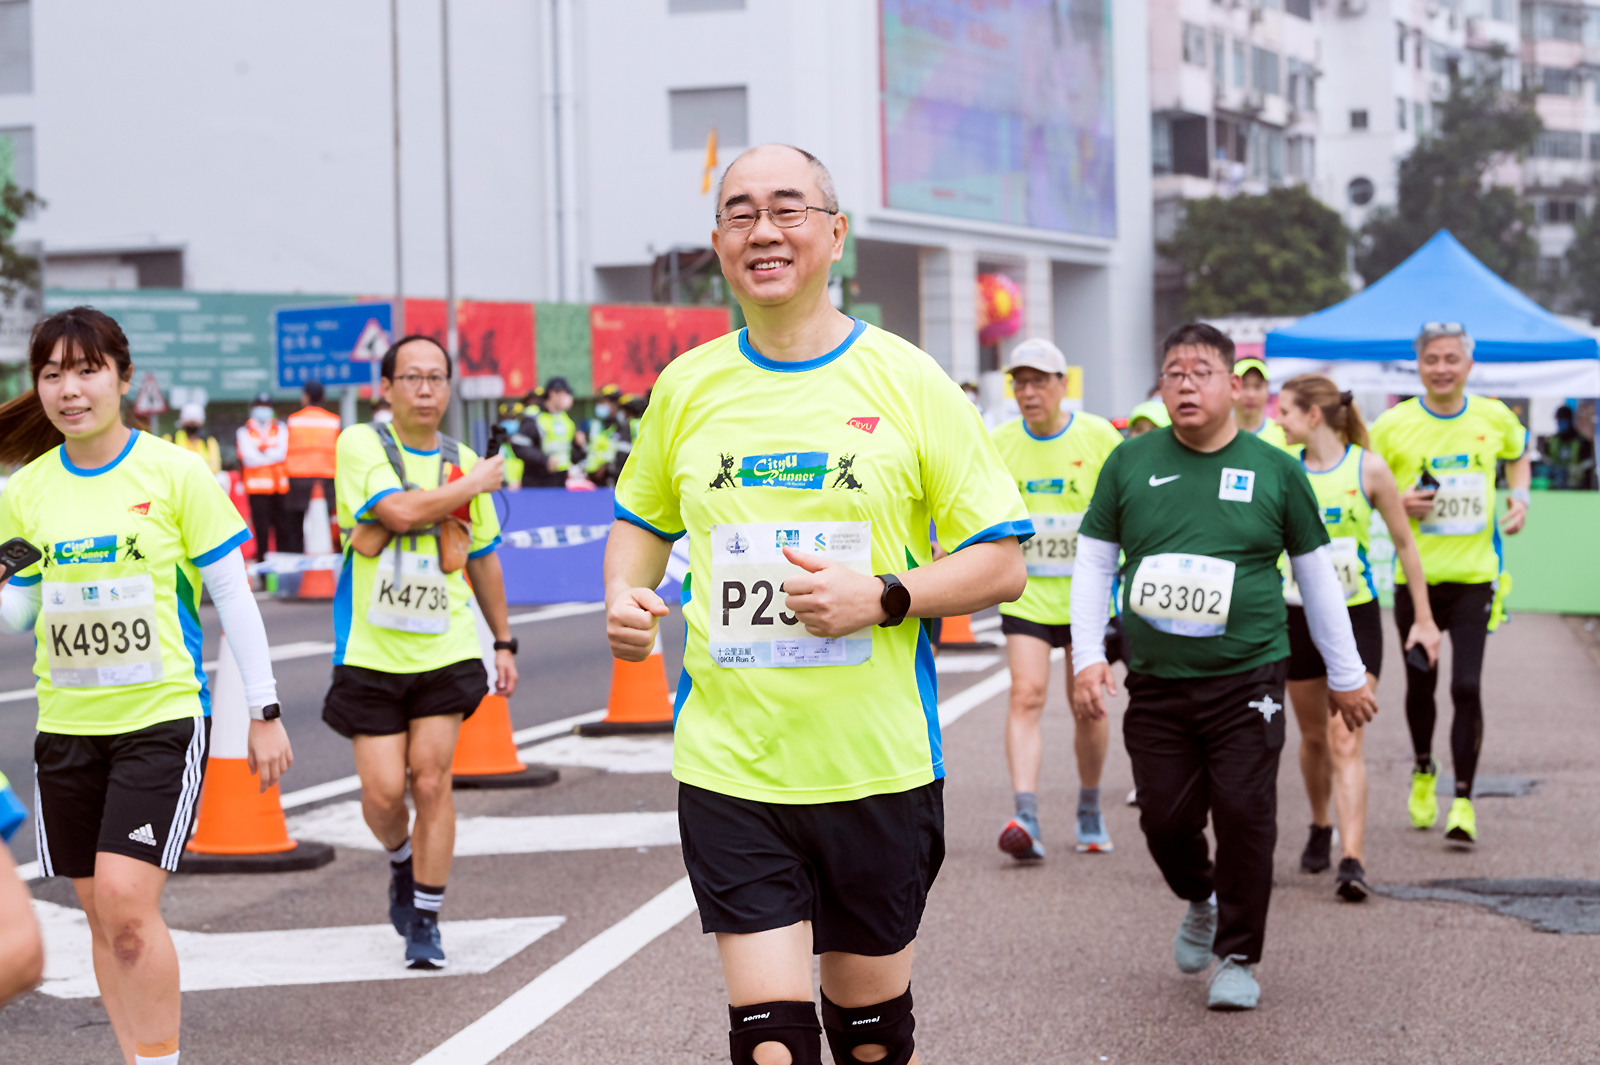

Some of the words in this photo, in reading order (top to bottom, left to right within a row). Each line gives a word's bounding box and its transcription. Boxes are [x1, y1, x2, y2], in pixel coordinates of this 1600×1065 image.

[850, 420, 873, 430] CityU
[754, 454, 798, 476] CityU
[762, 469, 815, 485] Runner
[62, 538, 94, 557] CityU
[70, 550, 109, 563] Runner
[379, 579, 448, 610] K4736
[1140, 582, 1222, 615] P3302
[51, 618, 151, 657] K4939
